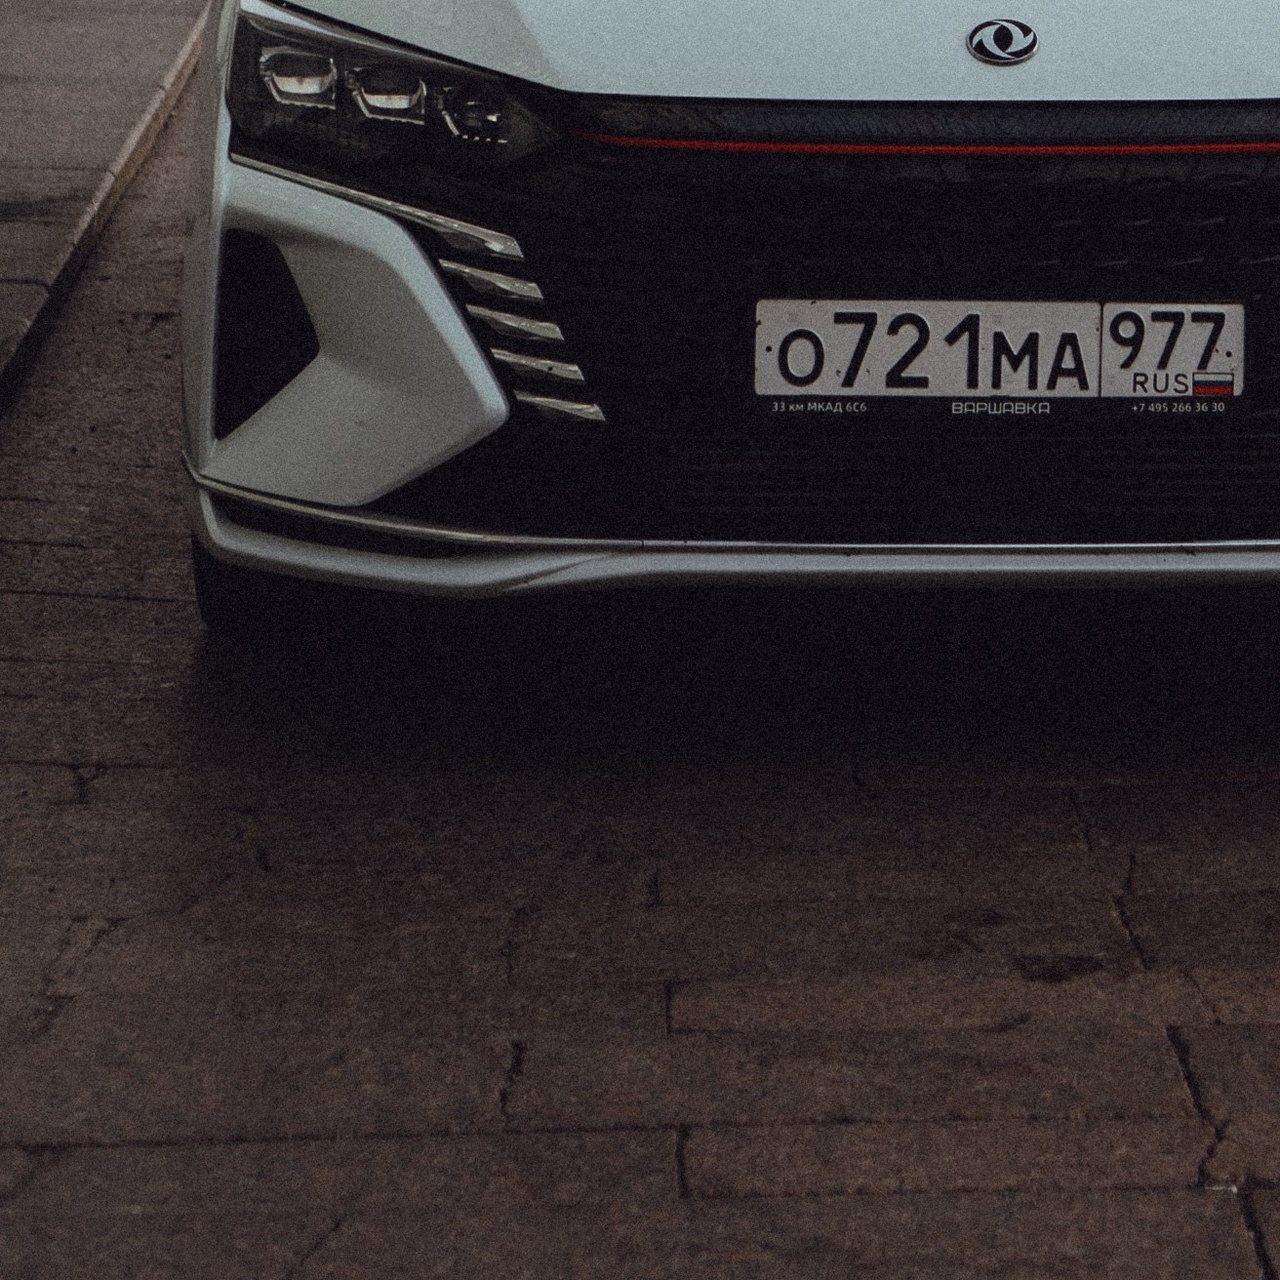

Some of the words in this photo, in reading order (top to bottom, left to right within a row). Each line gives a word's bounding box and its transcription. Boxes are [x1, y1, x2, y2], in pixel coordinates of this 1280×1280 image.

[1109, 310, 1227, 370] 977
[1132, 372, 1189, 394] RUS
[771, 401, 786, 412] 33
[806, 401, 843, 413] МКАД
[951, 401, 1051, 414] ВАРШАВКА
[1132, 402, 1145, 413] +7
[1147, 402, 1169, 413] 495
[1171, 402, 1192, 413] 266
[1194, 402, 1209, 413] 36
[1211, 401, 1225, 413] 30
